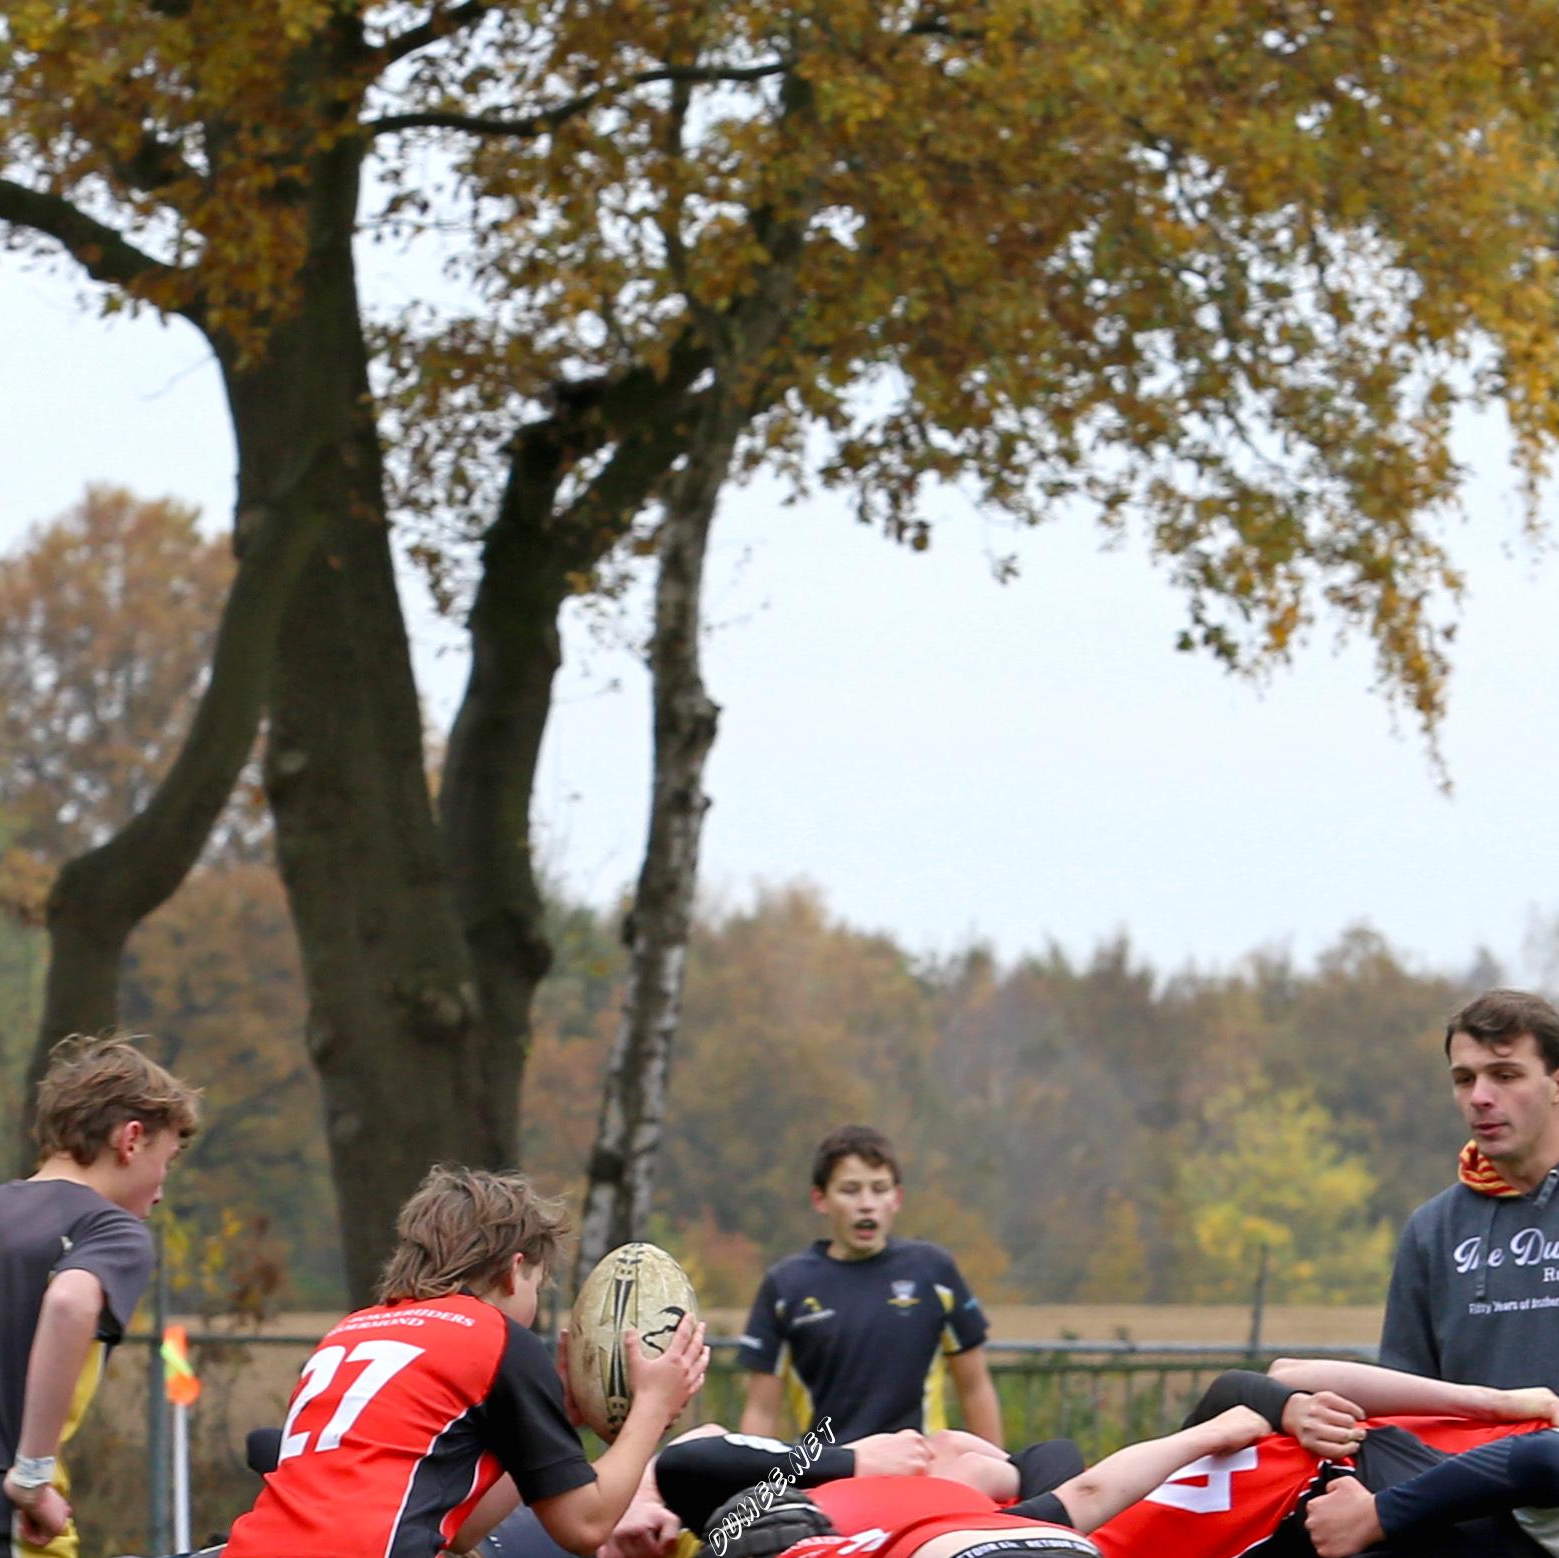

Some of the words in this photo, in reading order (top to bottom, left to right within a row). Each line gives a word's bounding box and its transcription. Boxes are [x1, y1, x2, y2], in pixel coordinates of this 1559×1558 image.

[1453, 1236, 1505, 1274] Te
[1519, 1297, 1531, 1310] of
[278, 1340, 426, 1466] 27
[1143, 1446, 1258, 1514] 4
